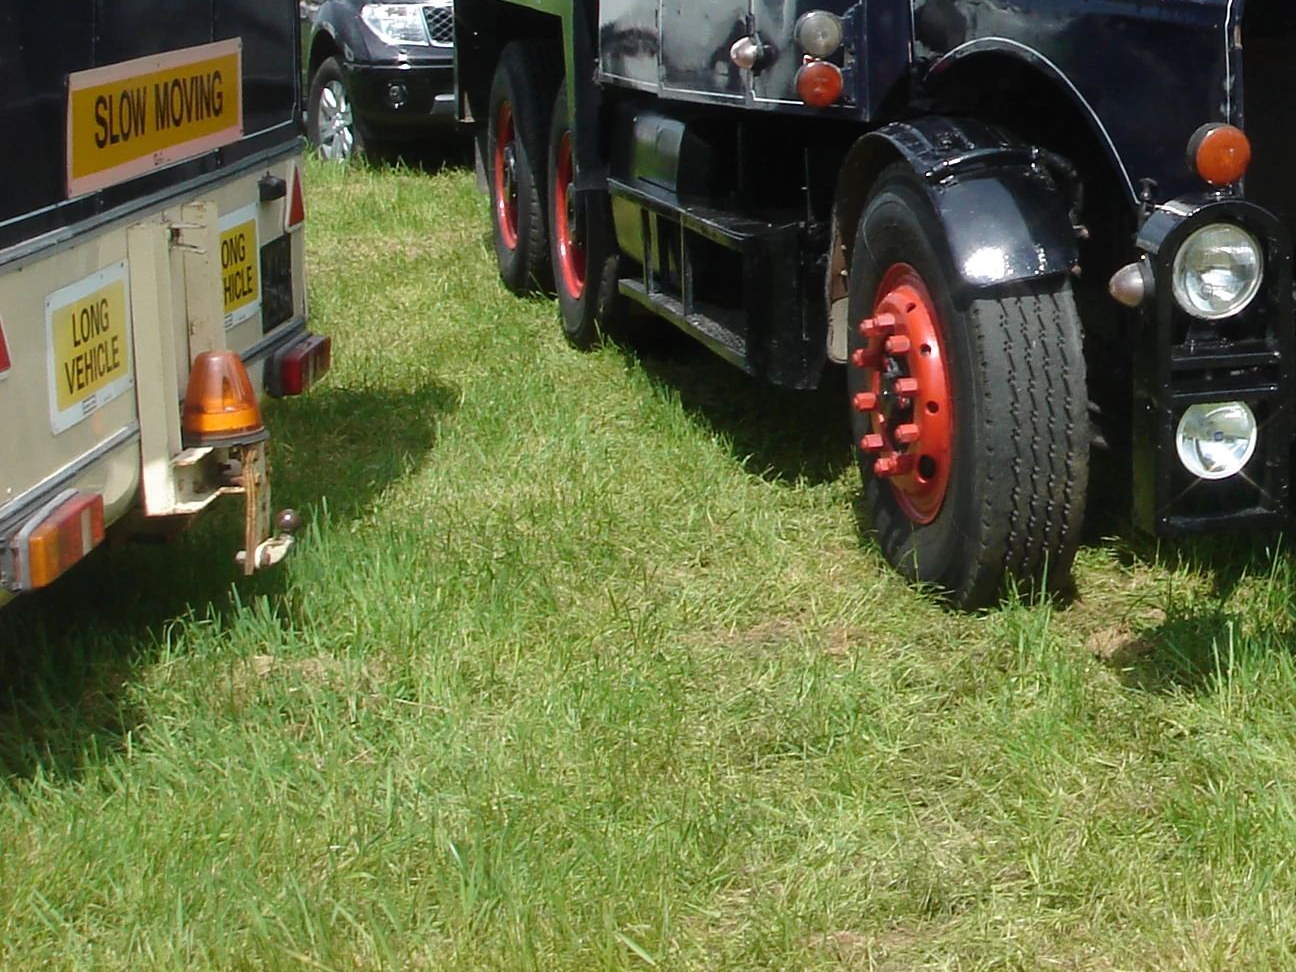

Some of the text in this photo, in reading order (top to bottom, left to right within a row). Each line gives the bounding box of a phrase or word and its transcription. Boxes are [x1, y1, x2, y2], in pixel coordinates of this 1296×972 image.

[94, 70, 223, 149] SLOW MOVING
[220, 233, 246, 269] ONG
[222, 265, 253, 306] HICLE
[72, 298, 110, 347] LONG
[64, 334, 120, 395] VEHICLE
